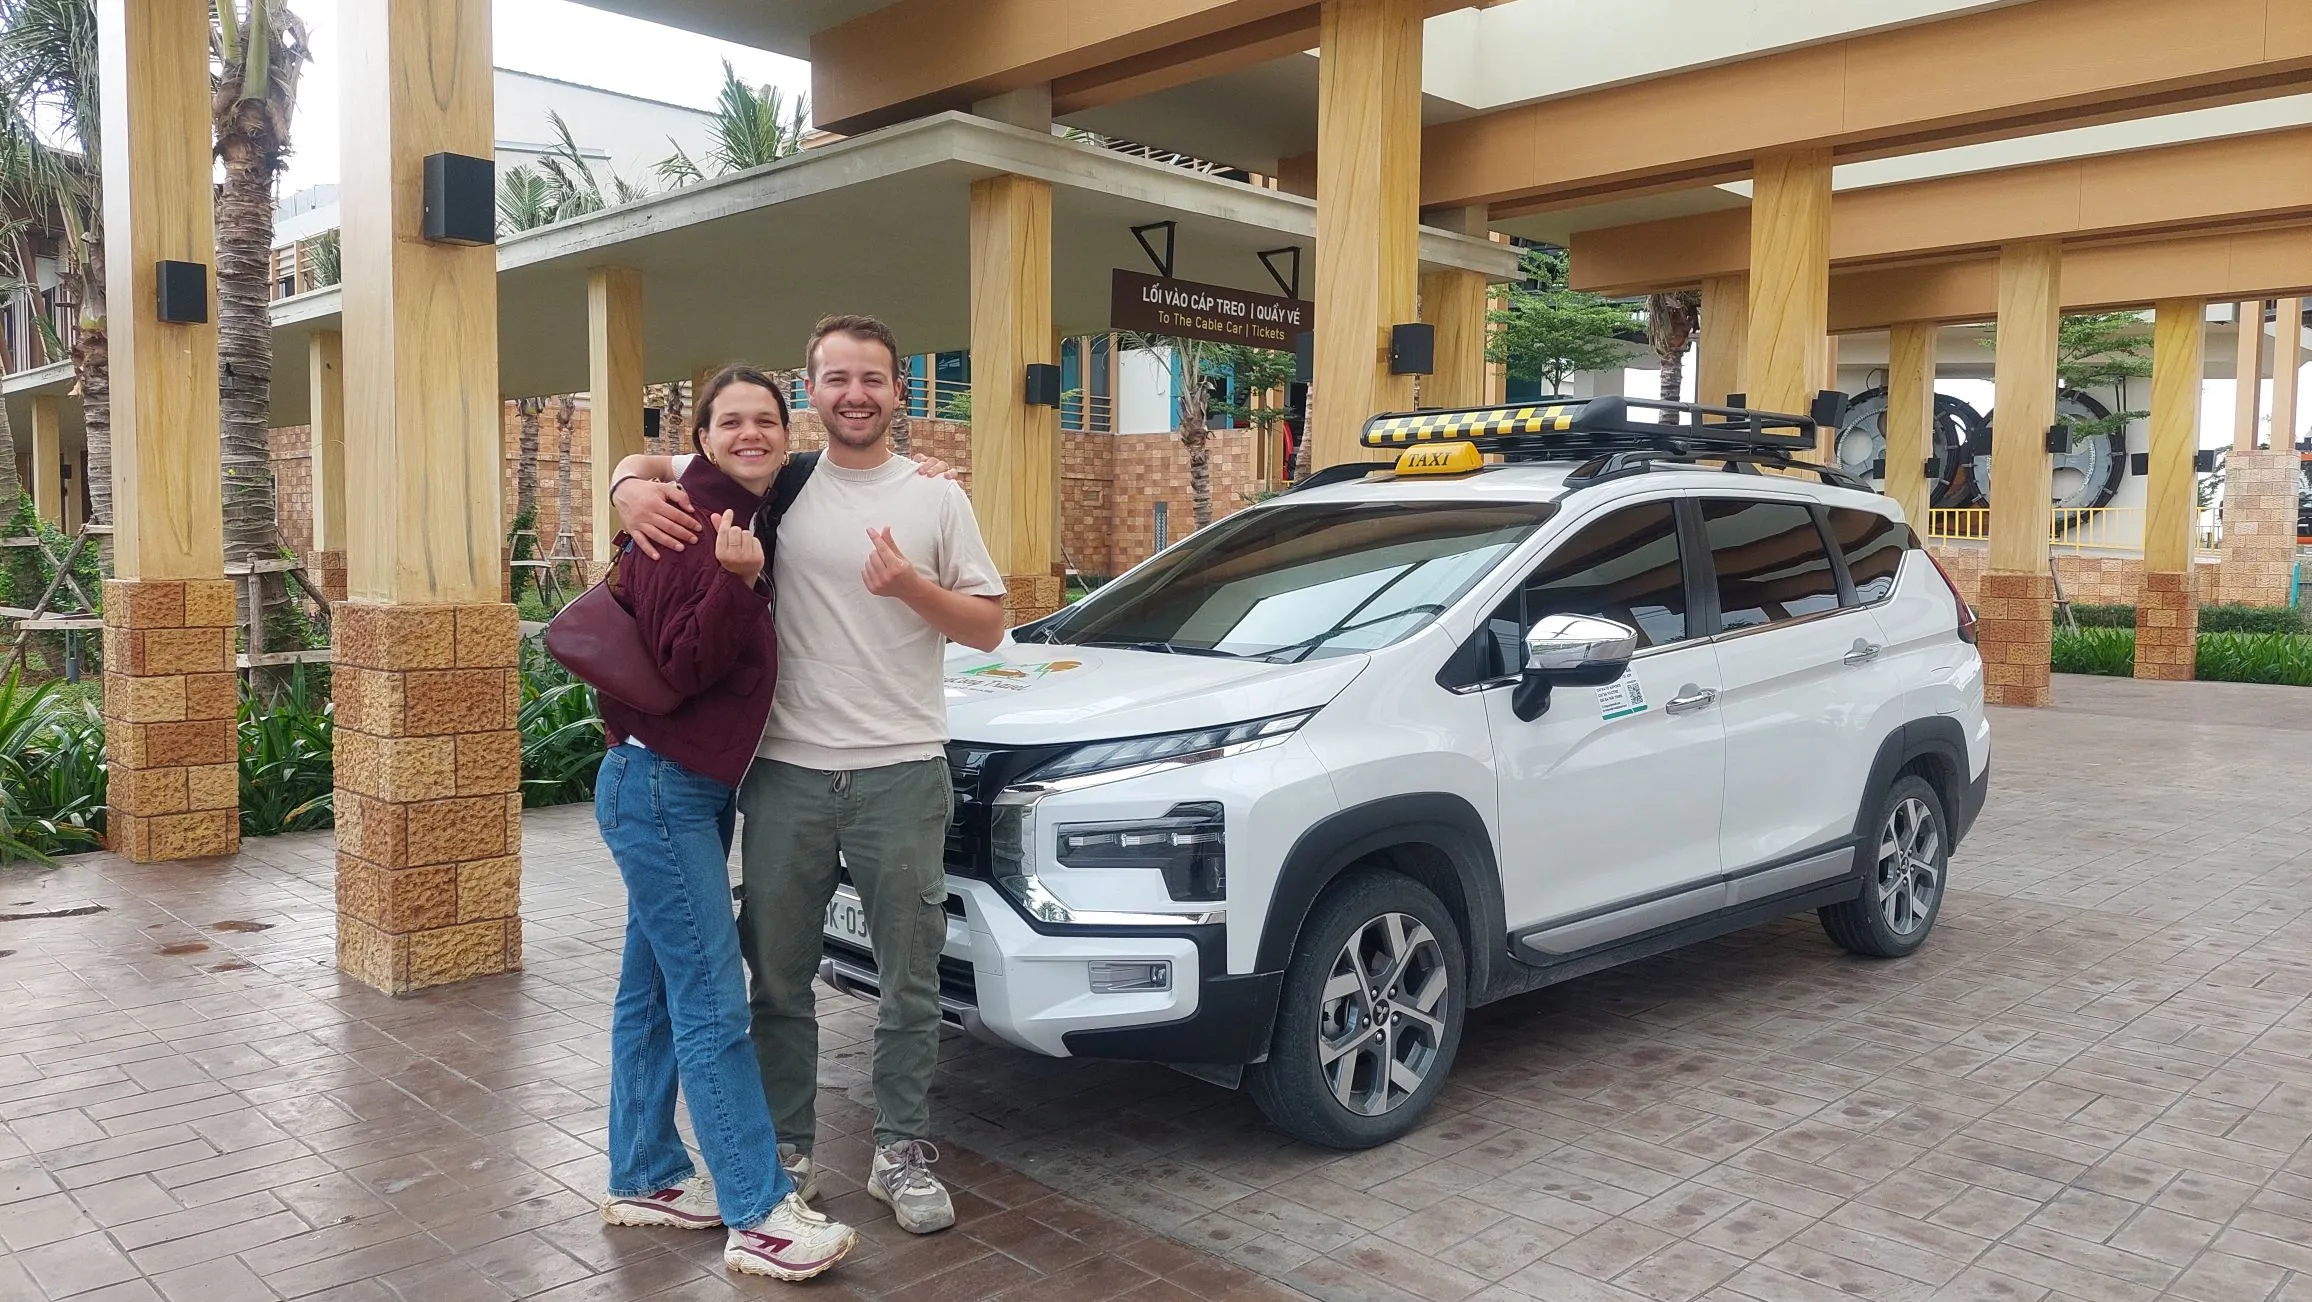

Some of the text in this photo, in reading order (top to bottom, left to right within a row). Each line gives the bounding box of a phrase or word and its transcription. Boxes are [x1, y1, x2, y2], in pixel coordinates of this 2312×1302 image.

[1142, 283, 1162, 303] LỐI
[1164, 288, 1188, 308] VÀO
[1191, 292, 1214, 311] CÁP
[1216, 299, 1246, 317] TREO
[1256, 303, 1285, 323] QUẦY
[1287, 307, 1301, 325] VÉ
[1158, 310, 1170, 324] To
[1173, 313, 1192, 327] The
[1195, 316, 1223, 332] Cable
[1226, 321, 1243, 335] Car
[1252, 324, 1285, 340] Tickets
[1407, 452, 1452, 468] TAXI
